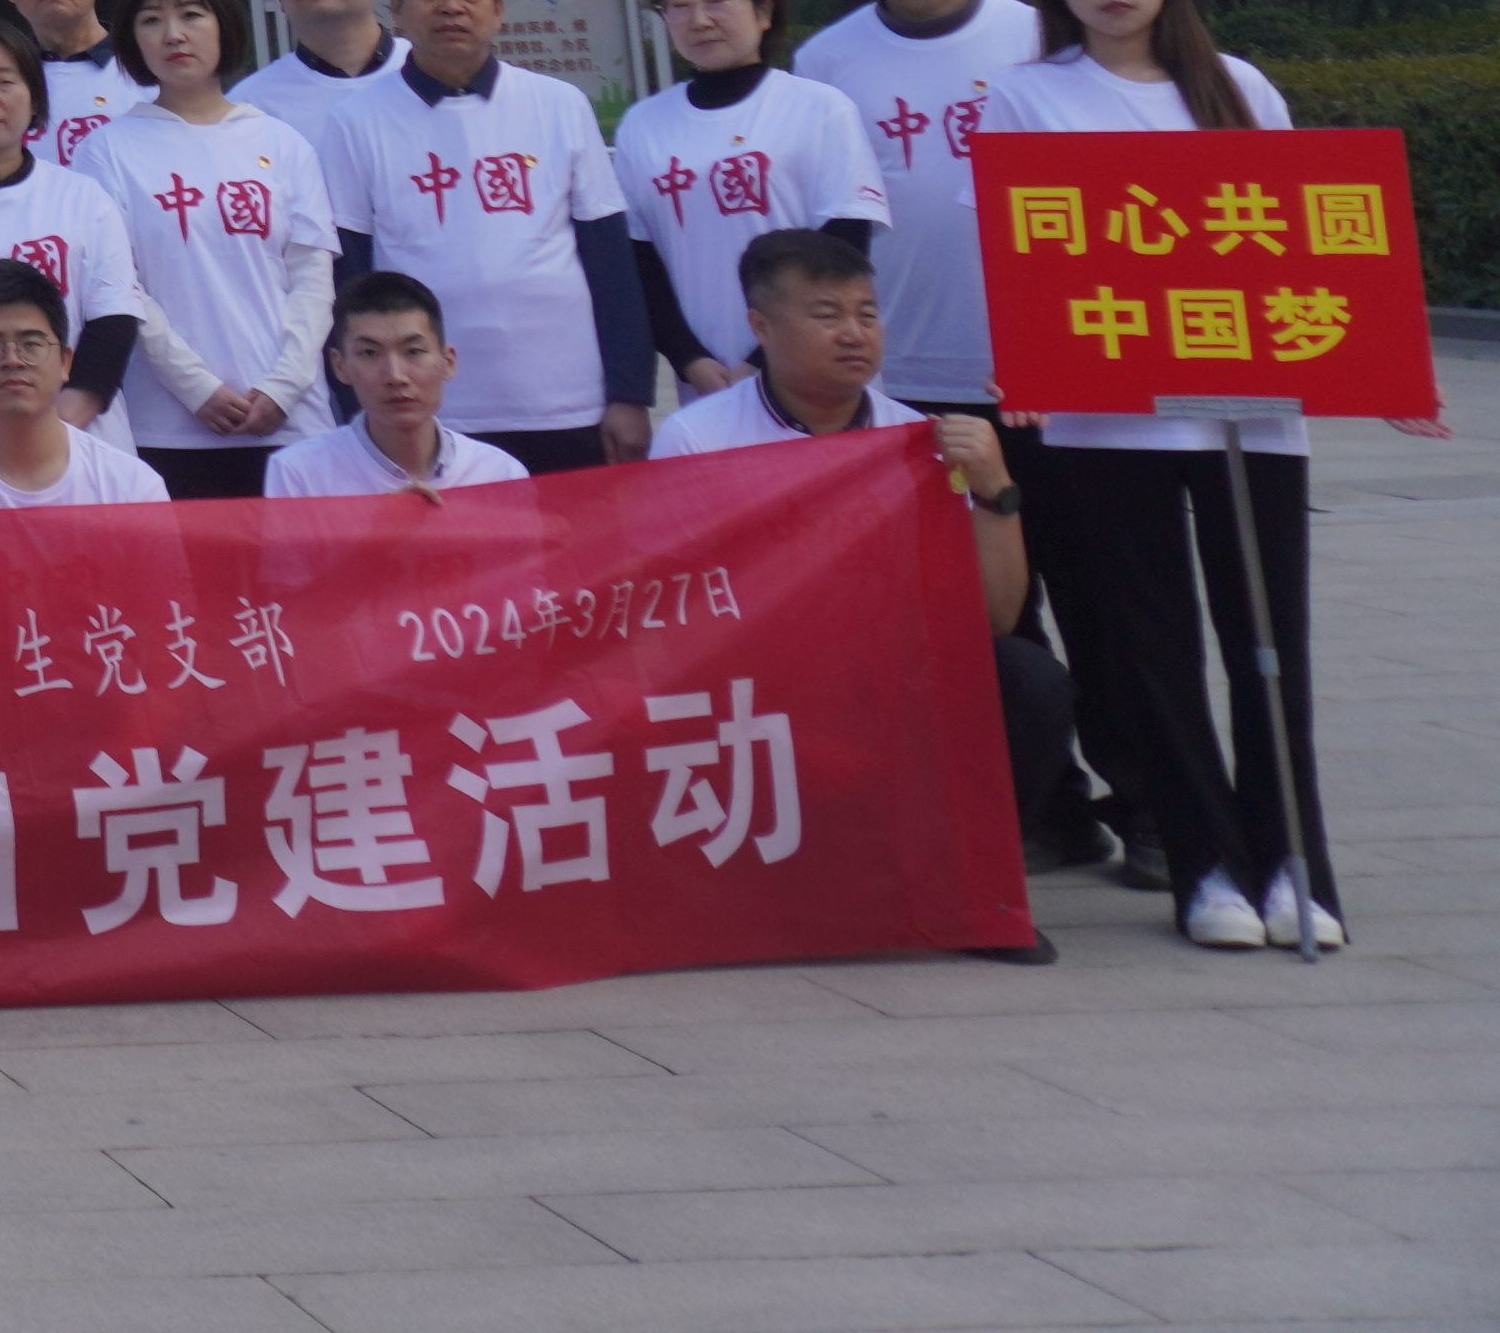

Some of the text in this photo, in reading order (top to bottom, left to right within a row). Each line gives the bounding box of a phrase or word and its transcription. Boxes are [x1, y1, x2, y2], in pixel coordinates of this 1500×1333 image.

[1009, 182, 1392, 258] 同心共圆
[1069, 286, 1354, 363] 中国梦
[398, 566, 741, 663] 2024年3月27日
